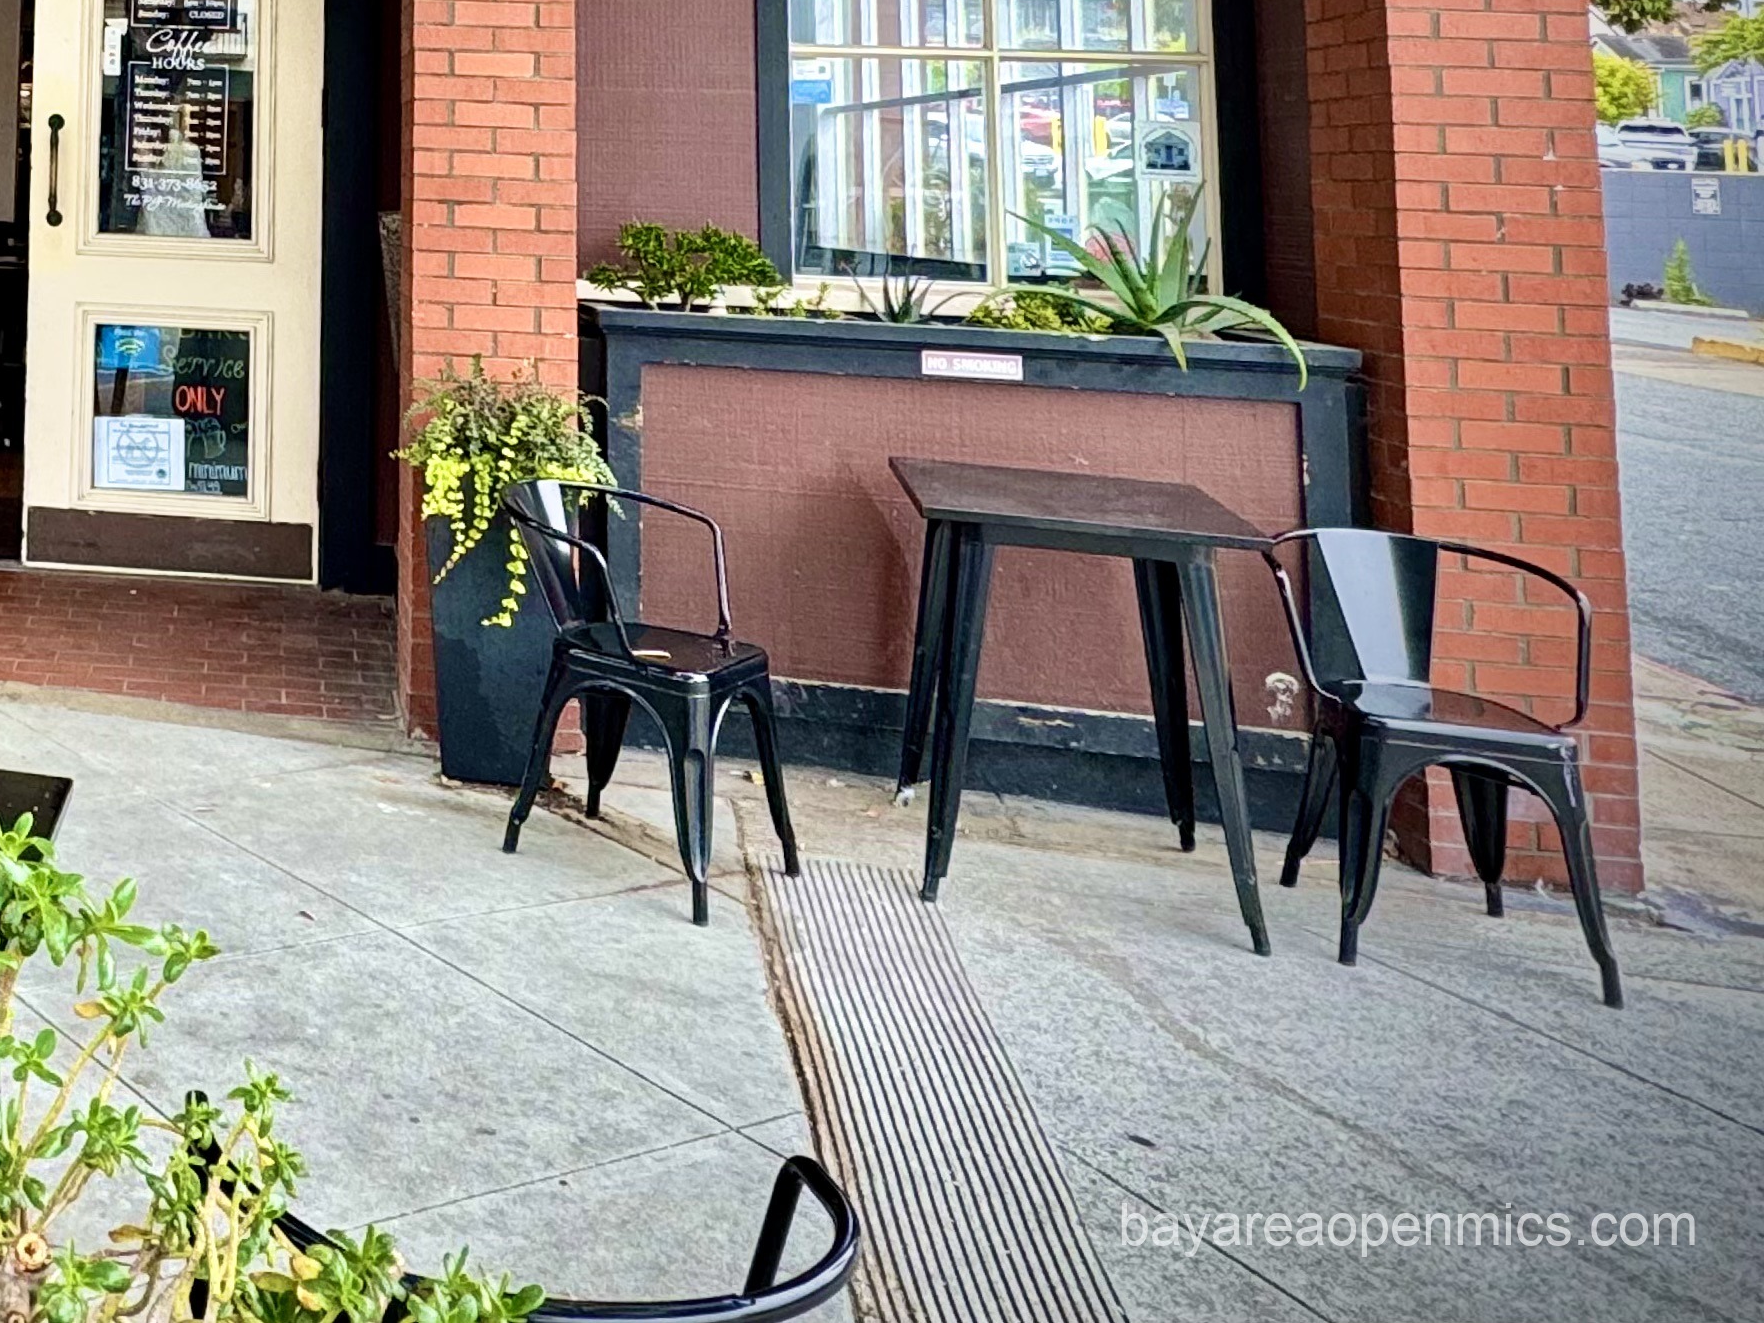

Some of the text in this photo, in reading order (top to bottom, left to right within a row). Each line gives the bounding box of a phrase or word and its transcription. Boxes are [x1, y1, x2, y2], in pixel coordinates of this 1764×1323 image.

[151, 56, 205, 71] HOURS
[163, 345, 245, 378] Service
[926, 357, 1017, 374] NO SMOKING
[176, 385, 225, 416] ONLY
